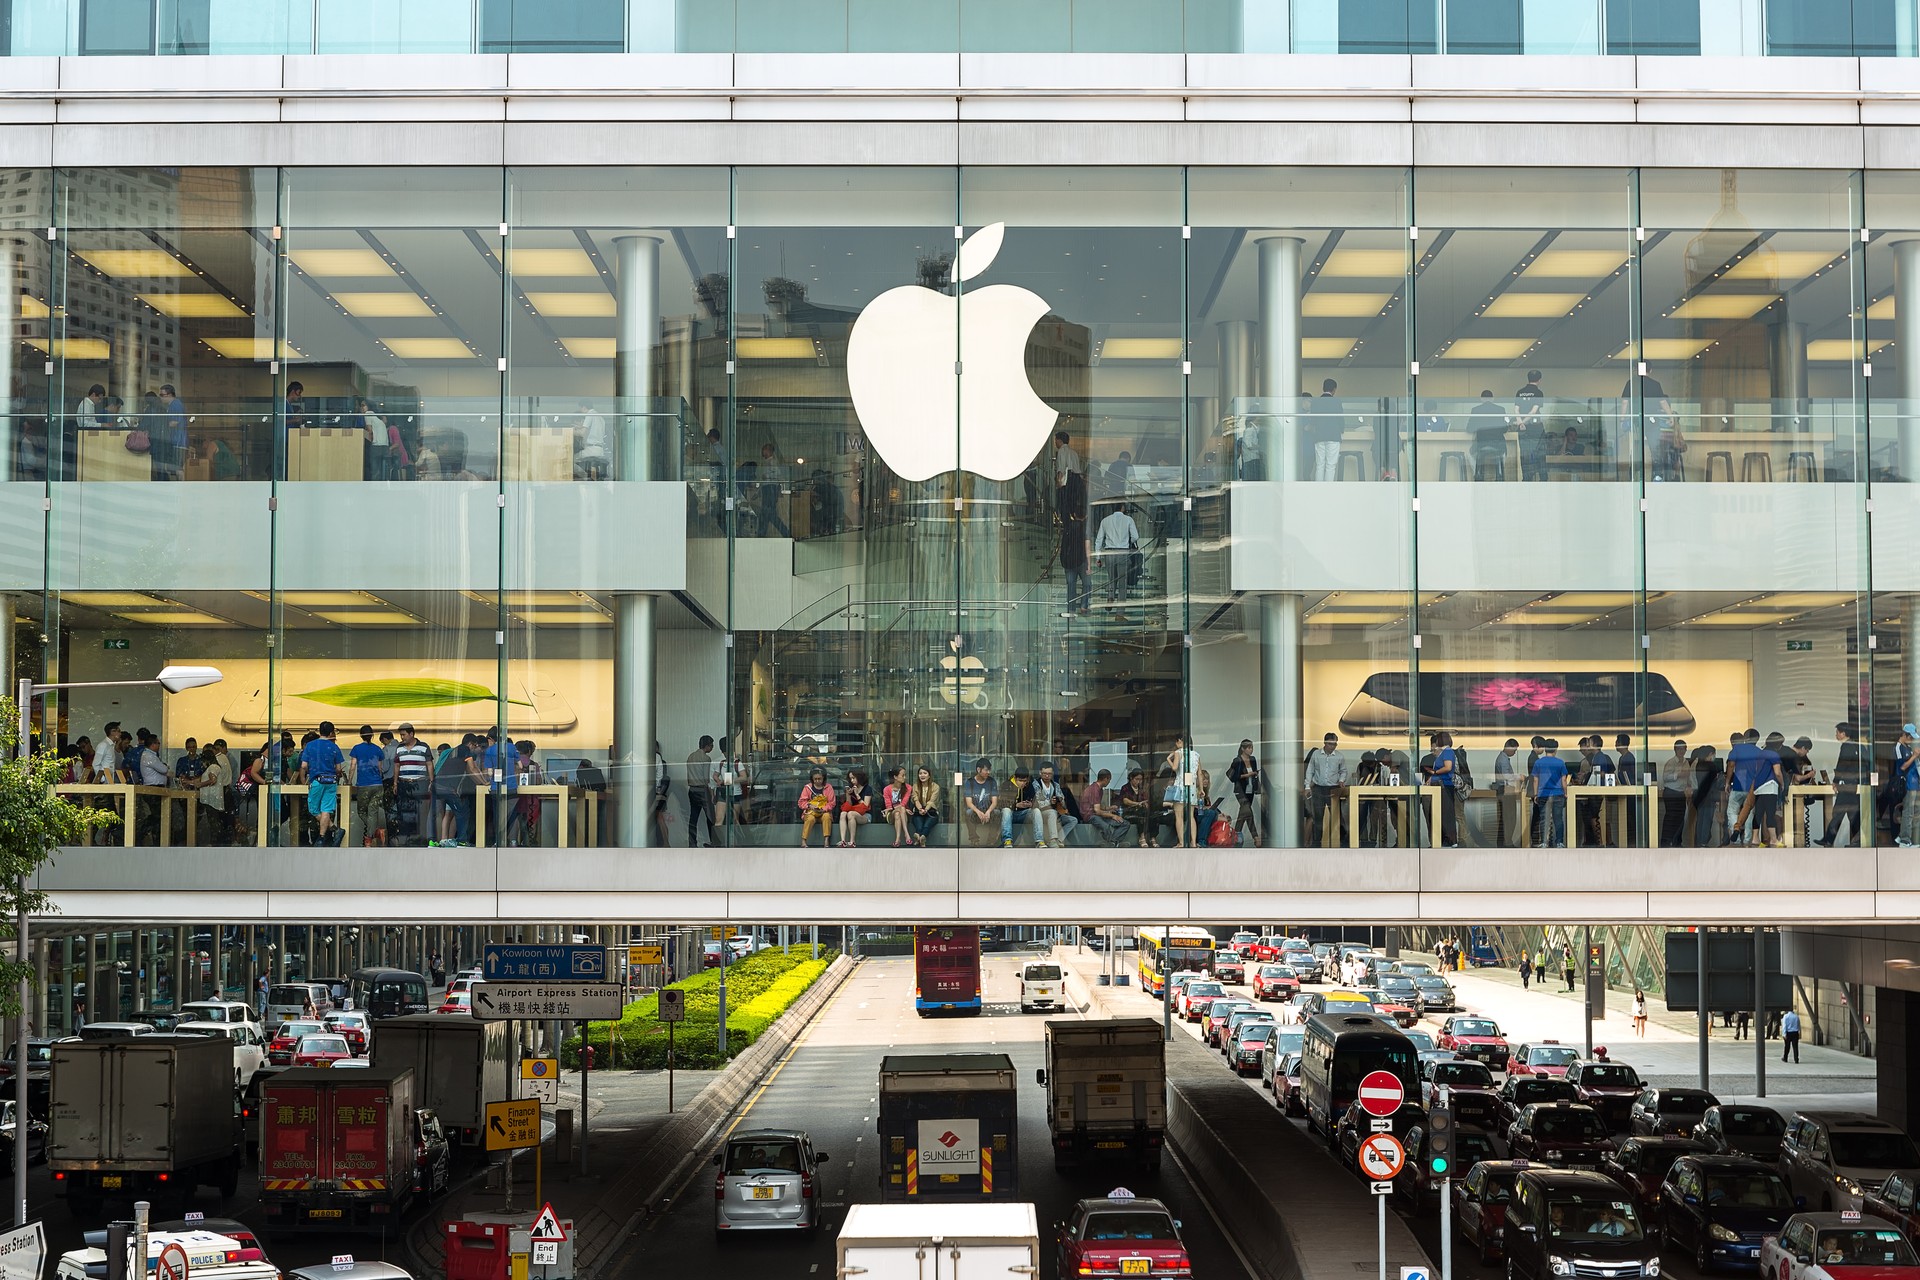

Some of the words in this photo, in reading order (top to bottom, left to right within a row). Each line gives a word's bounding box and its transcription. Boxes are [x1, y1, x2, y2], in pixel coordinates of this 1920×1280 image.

[502, 948, 542, 958] Kowloon
[546, 948, 565, 958] (W)
[503, 963, 557, 976] 九龍(西)
[497, 988, 532, 998] Airport
[537, 988, 576, 998] Express
[581, 988, 618, 997] Station
[544, 1080, 551, 1089] 7
[544, 1093, 550, 1102] 7
[337, 1106, 377, 1125] 雪粒
[507, 1107, 536, 1118] Finance
[507, 1116, 529, 1127] Street
[508, 1128, 536, 1141] 金融街
[922, 1149, 976, 1161] SUNLIGHT
[12, 1234, 35, 1252] Station
[190, 1255, 213, 1265] POLICE
[334, 1255, 352, 1263] TAXI
